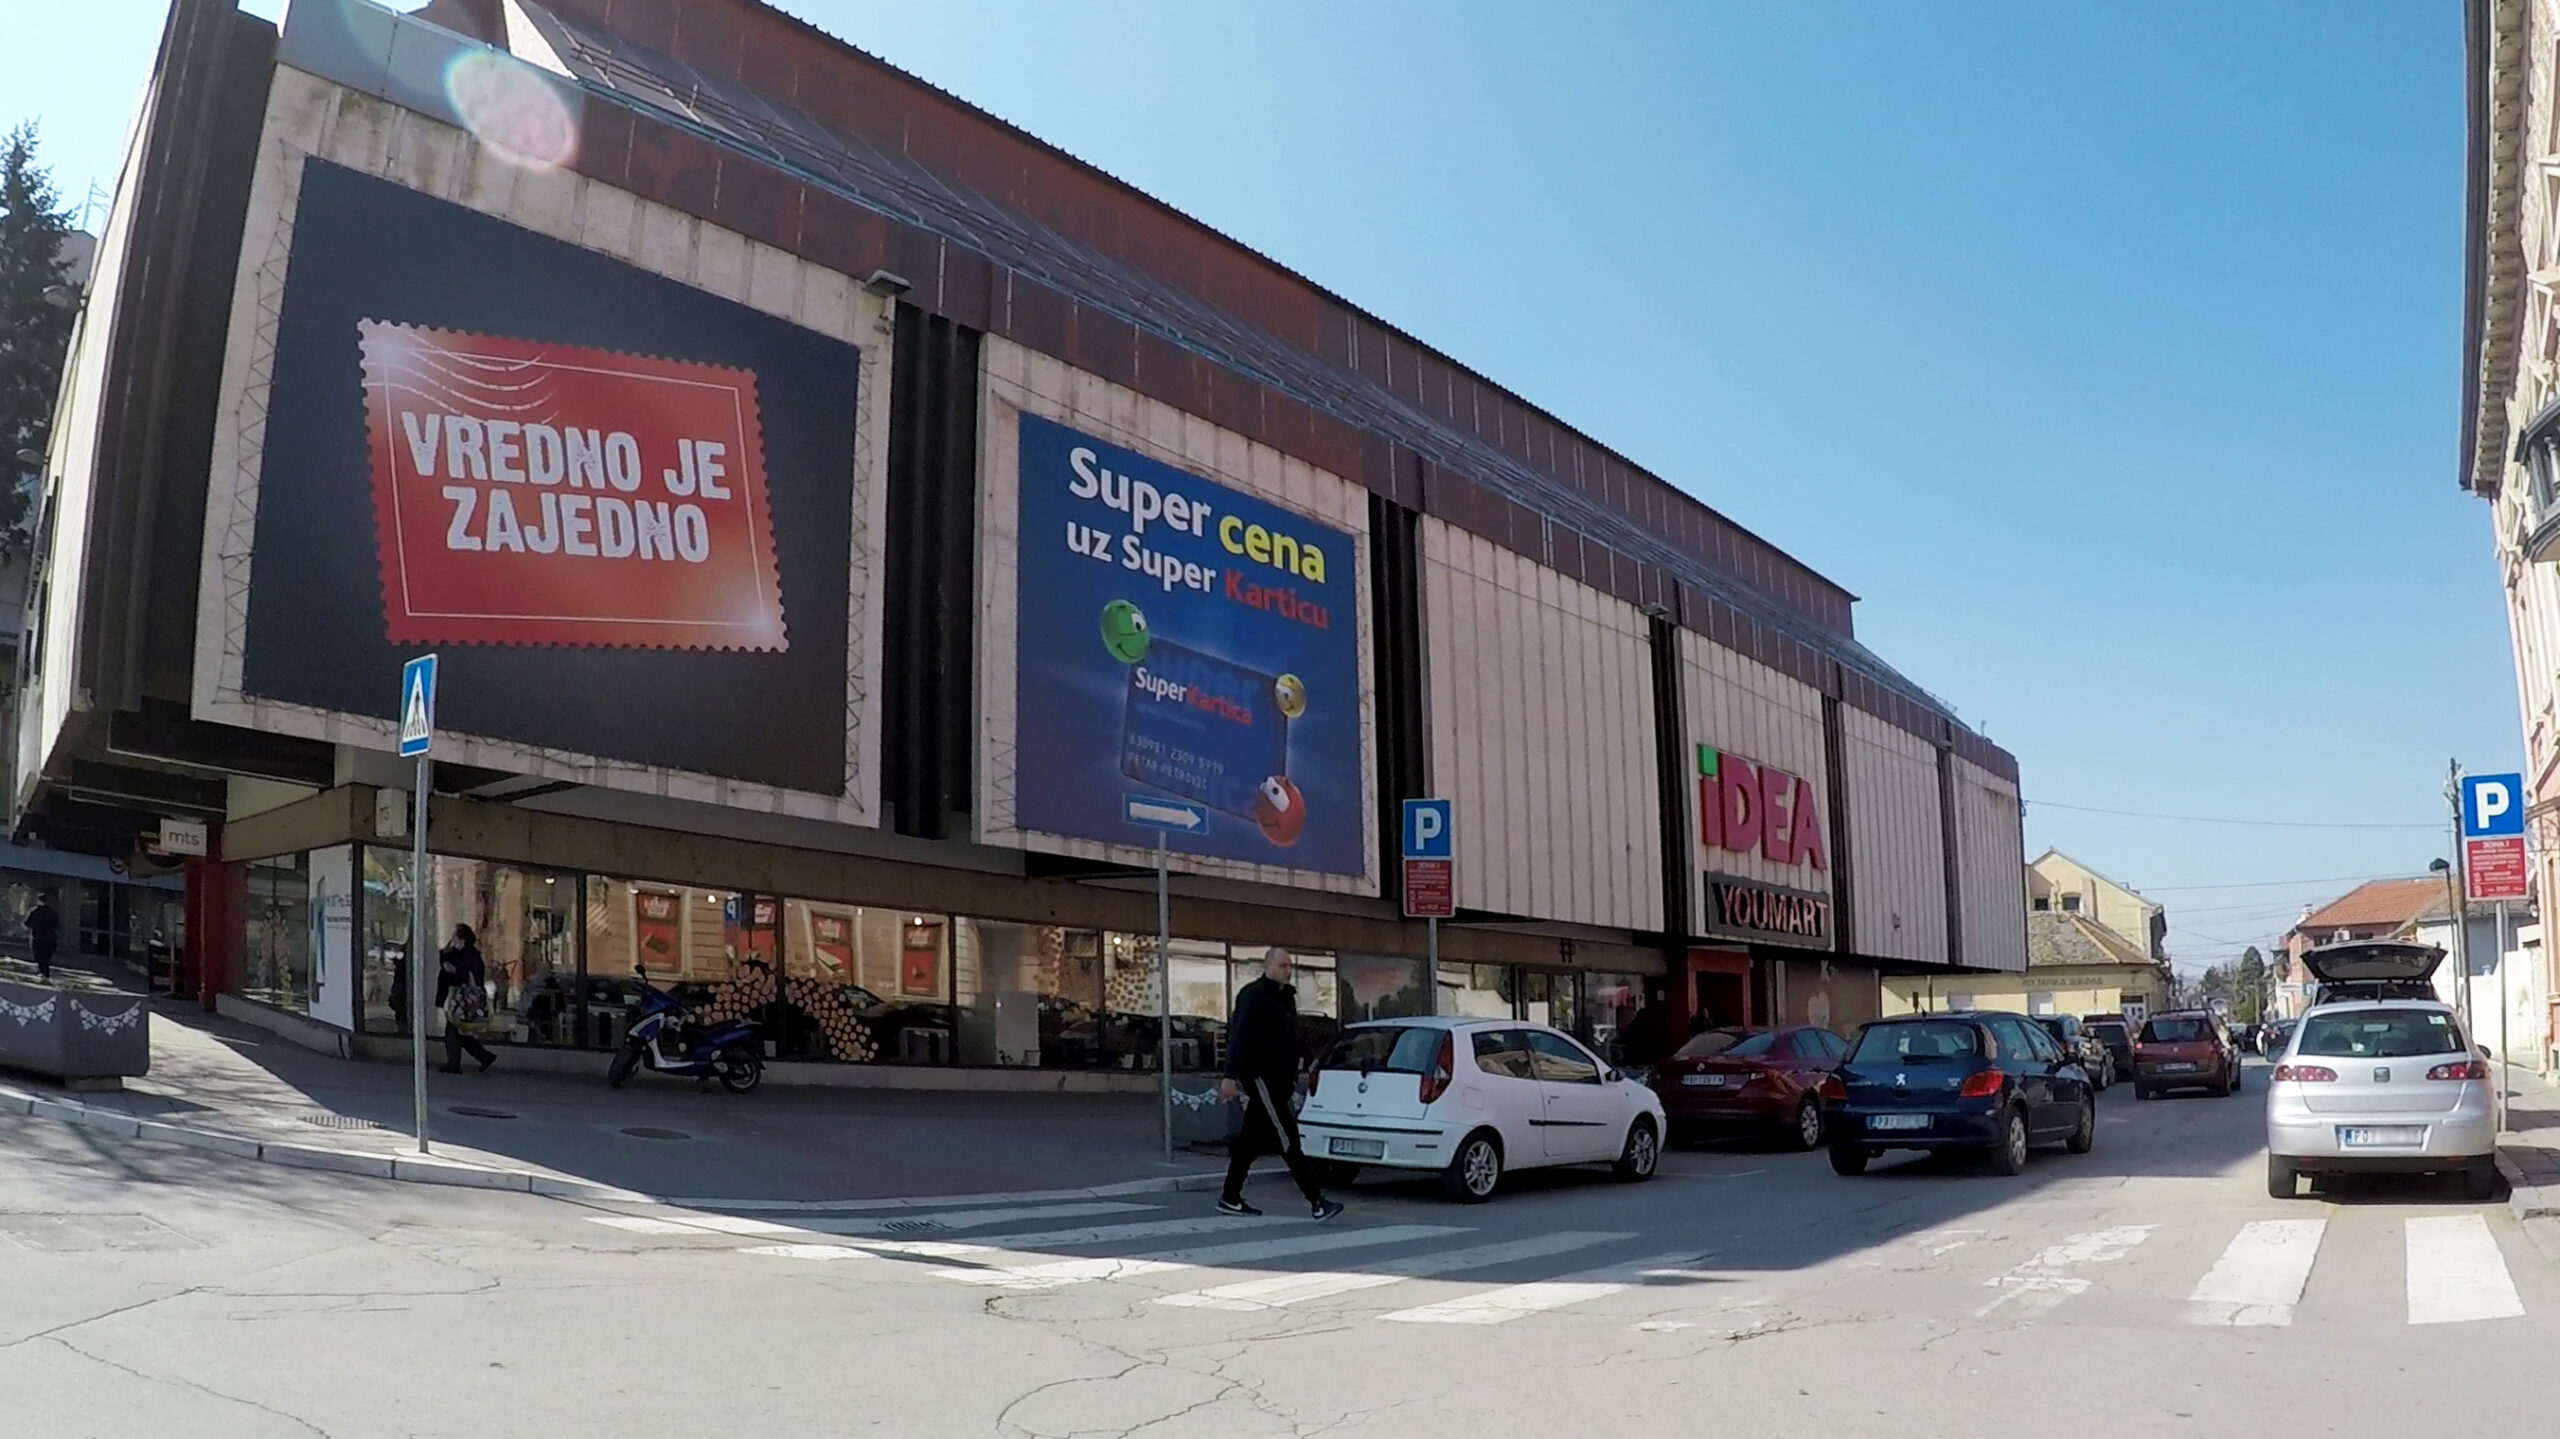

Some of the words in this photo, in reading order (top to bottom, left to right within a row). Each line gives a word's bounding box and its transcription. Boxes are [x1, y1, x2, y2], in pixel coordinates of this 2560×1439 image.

[402, 411, 642, 493] VREDNO
[663, 438, 731, 500] JE
[442, 485, 710, 564] ZAJEDNO
[1068, 447, 1213, 537] Super
[1218, 515, 1326, 584] cena
[1067, 521, 1112, 563] uz
[1121, 534, 1217, 593] Super
[1224, 568, 1328, 629] Karticu
[1415, 808, 1442, 850] P
[2475, 781, 2510, 829] P
[168, 831, 200, 846] mts
[1718, 884, 1828, 937] YOUMART
